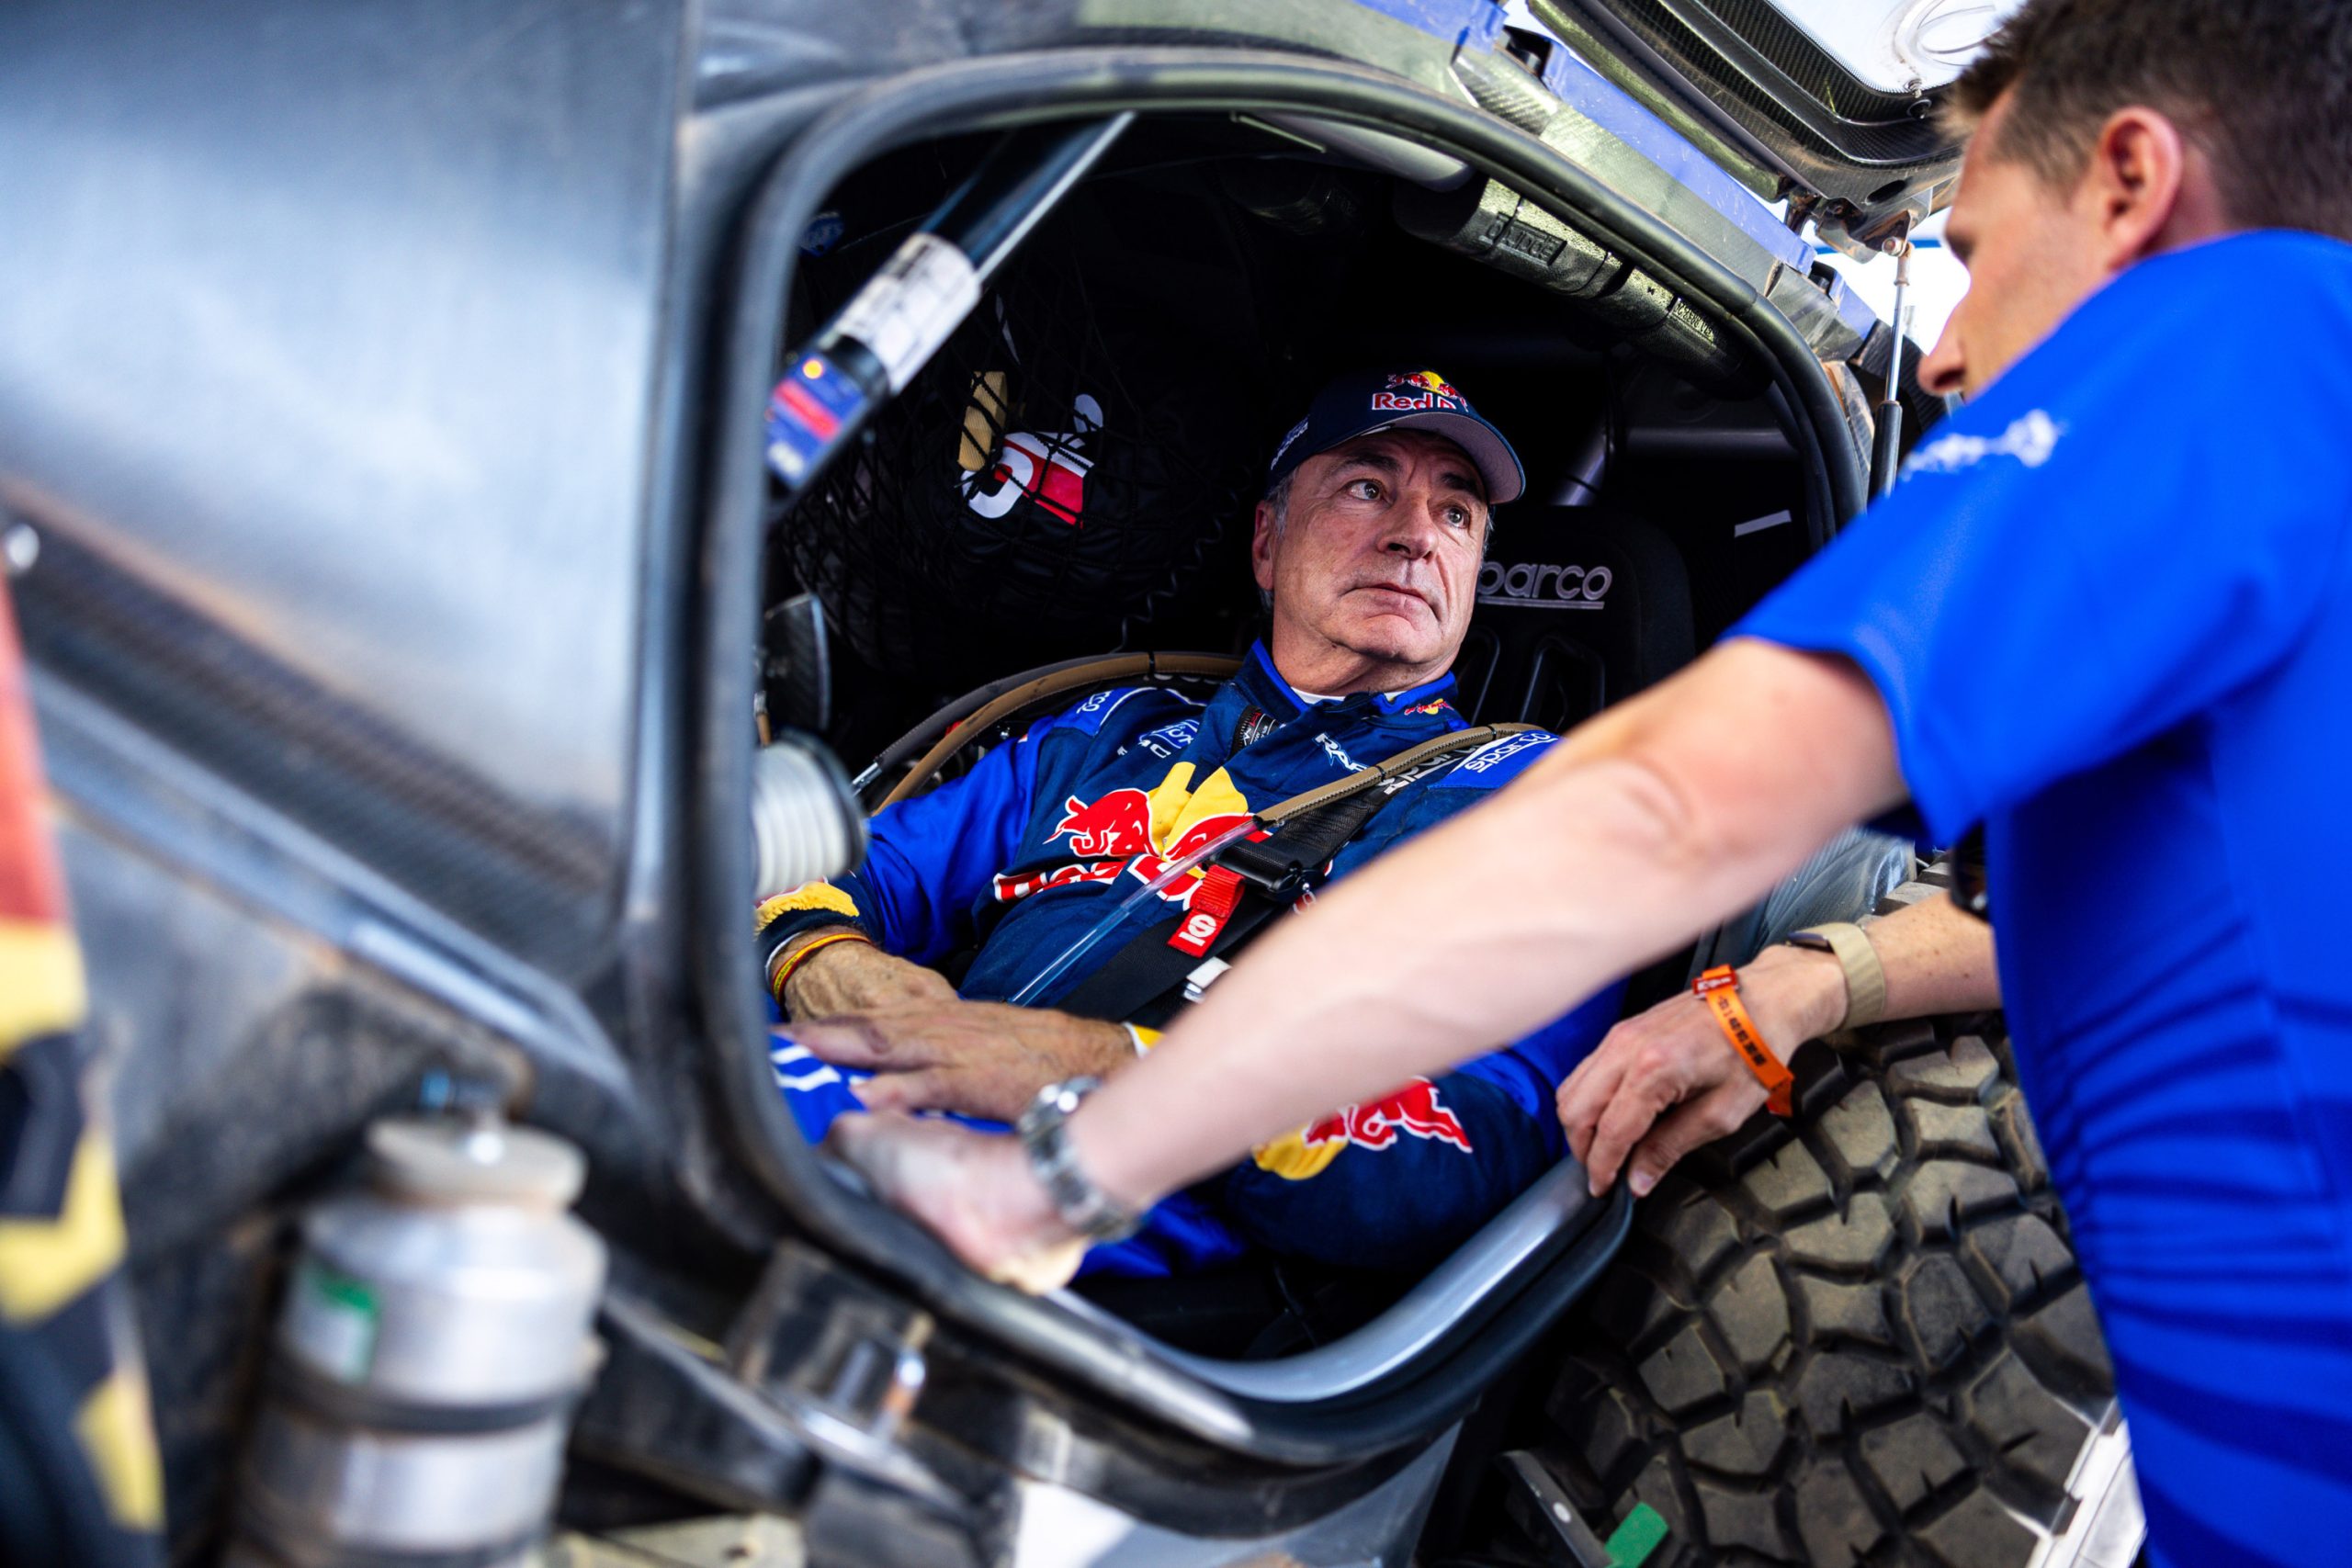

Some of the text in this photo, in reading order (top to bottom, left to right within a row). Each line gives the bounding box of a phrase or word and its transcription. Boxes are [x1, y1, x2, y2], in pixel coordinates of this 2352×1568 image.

[1372, 392, 1433, 411] Red
[1476, 561, 1612, 603] parco
[1464, 732, 1554, 773] sparco
